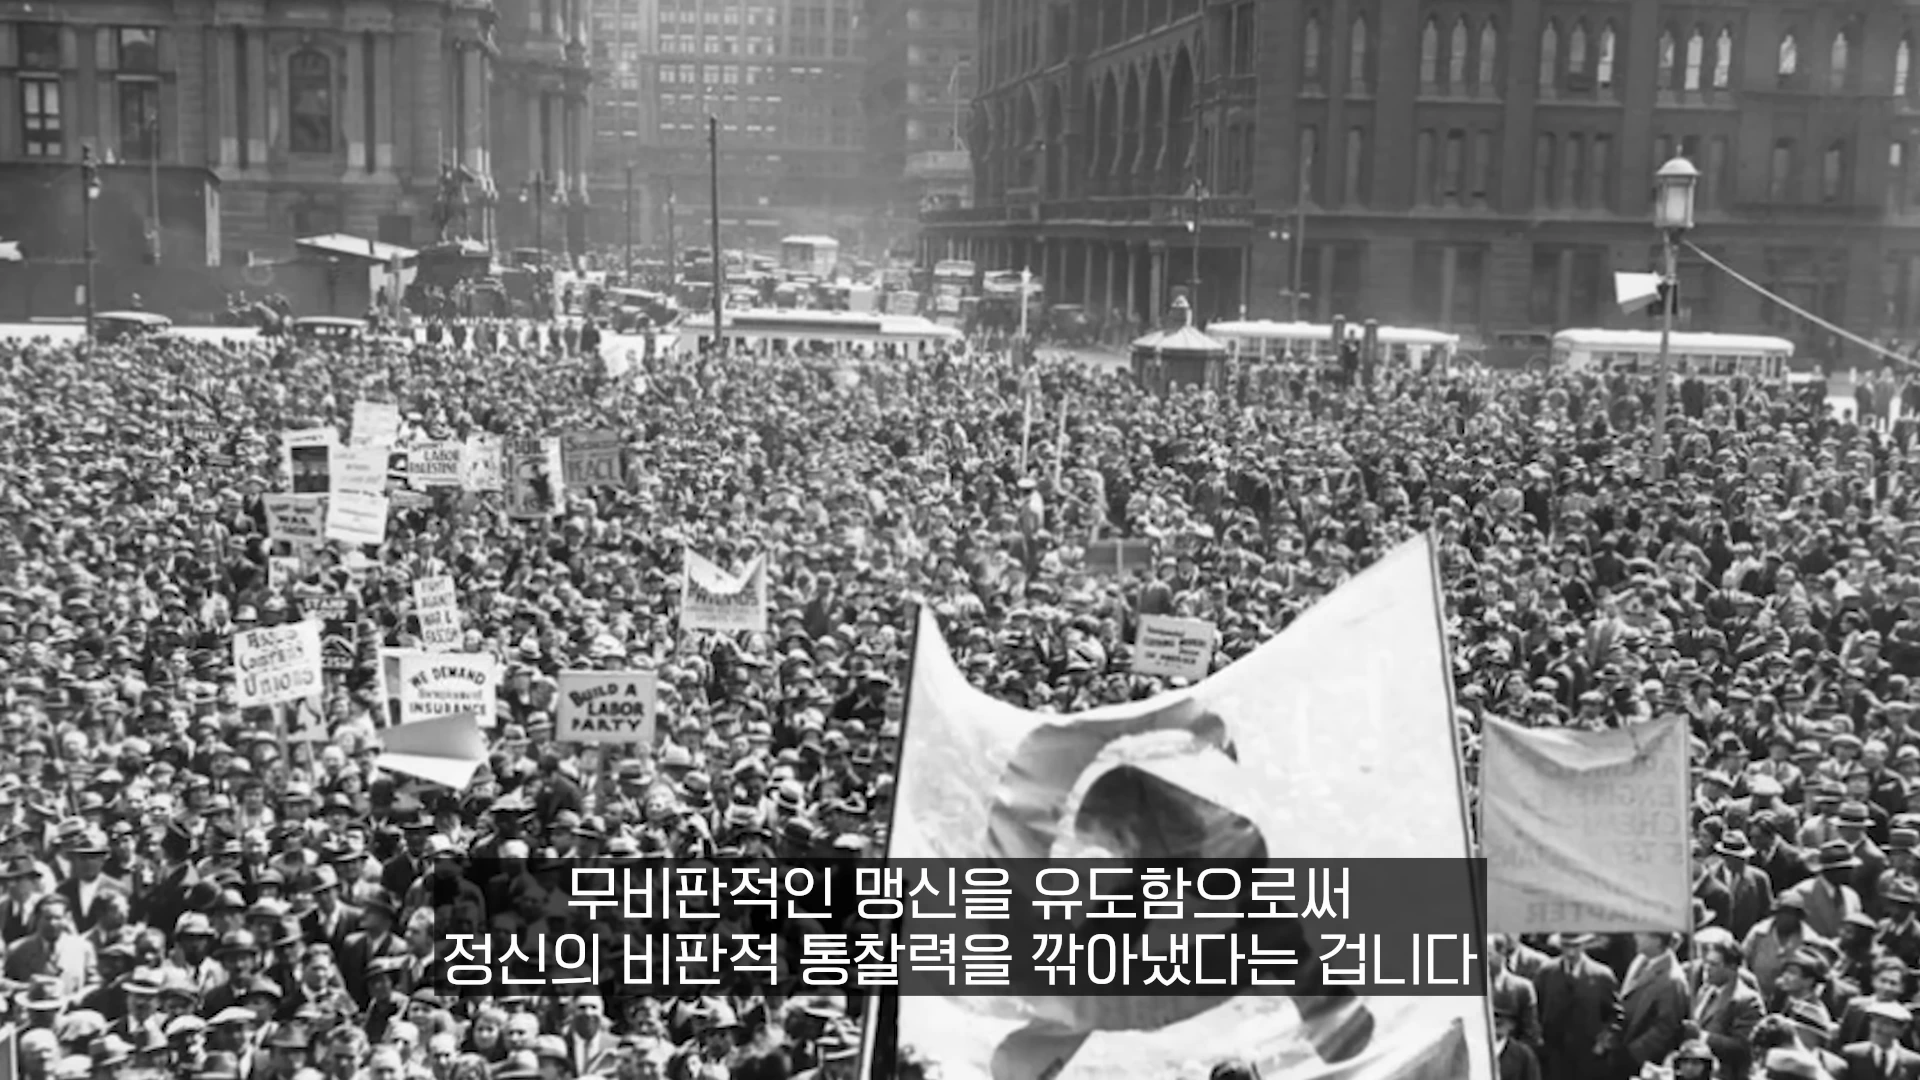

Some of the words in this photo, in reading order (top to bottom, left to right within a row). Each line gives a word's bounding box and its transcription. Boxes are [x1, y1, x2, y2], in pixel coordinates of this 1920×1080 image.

[424, 449, 460, 461] LABOR
[304, 598, 348, 609] STAMP
[432, 665, 487, 685] DEMAND
[568, 683, 619, 708] BUILD
[625, 683, 637, 697] A
[409, 702, 487, 716] INSURANCE
[588, 701, 645, 716] LABOR
[571, 718, 642, 732] PARTY
